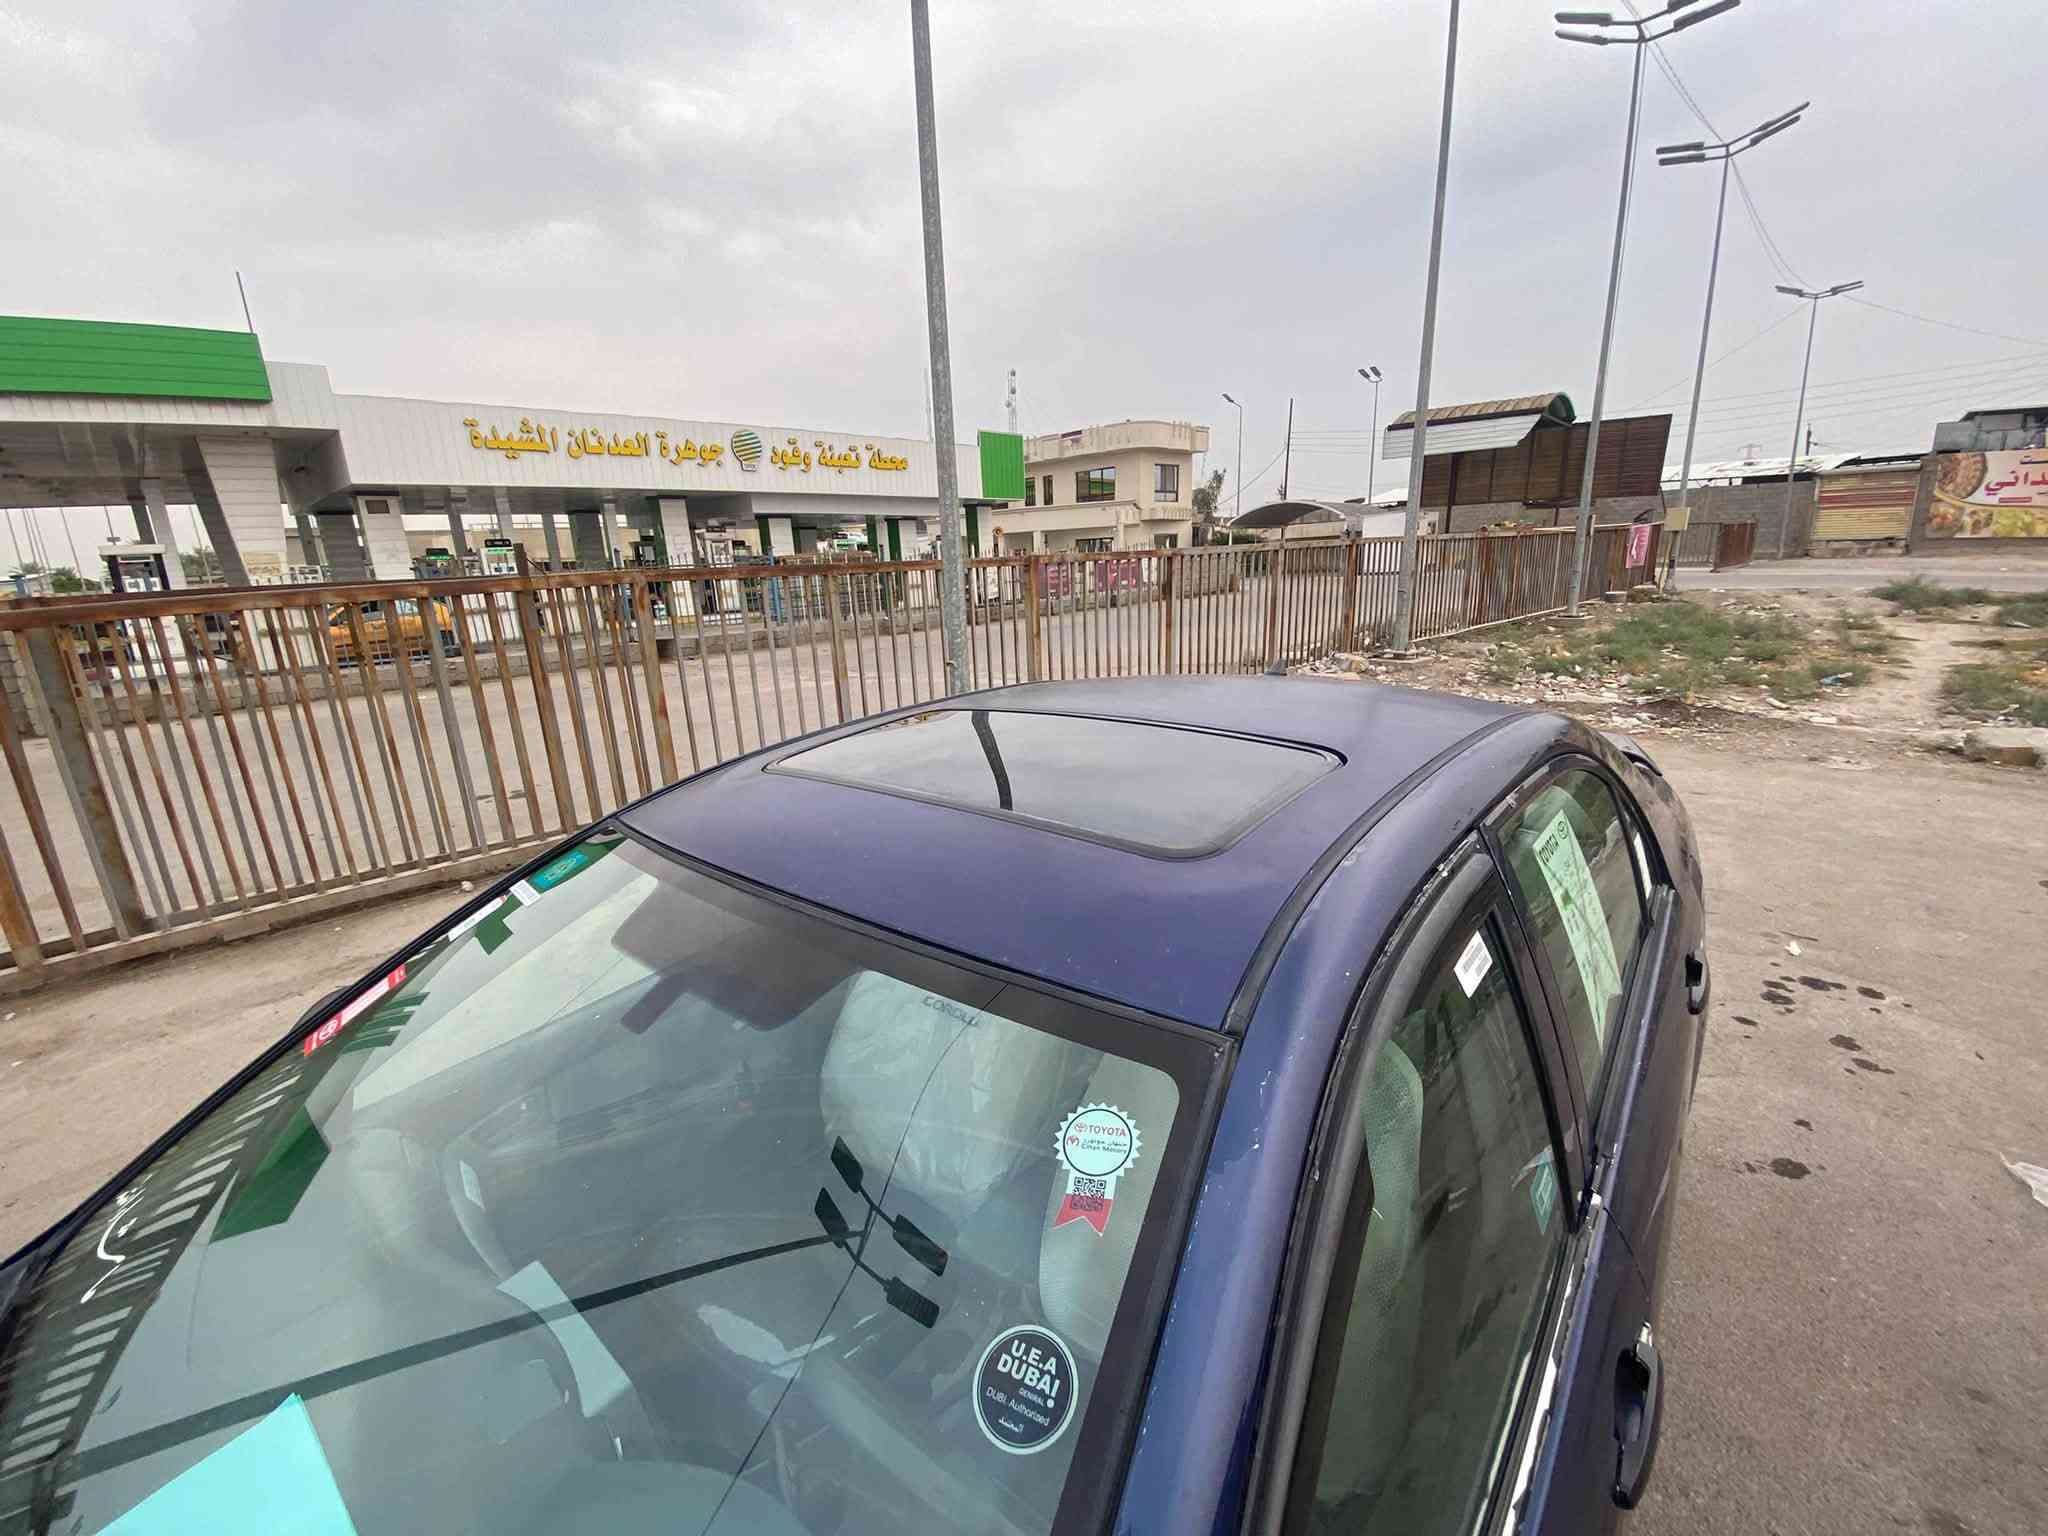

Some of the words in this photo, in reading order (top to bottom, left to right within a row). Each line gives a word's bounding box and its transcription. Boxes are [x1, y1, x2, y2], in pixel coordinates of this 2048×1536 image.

[567, 427, 650, 460] العدنان
[656, 430, 724, 467] جوهرة
[771, 437, 812, 473] وقود
[815, 440, 862, 474] تعبئة
[865, 443, 908, 471] محطة
[1089, 1124, 1126, 1136] TOYOTA
[1010, 1339, 1057, 1375] U.E.A
